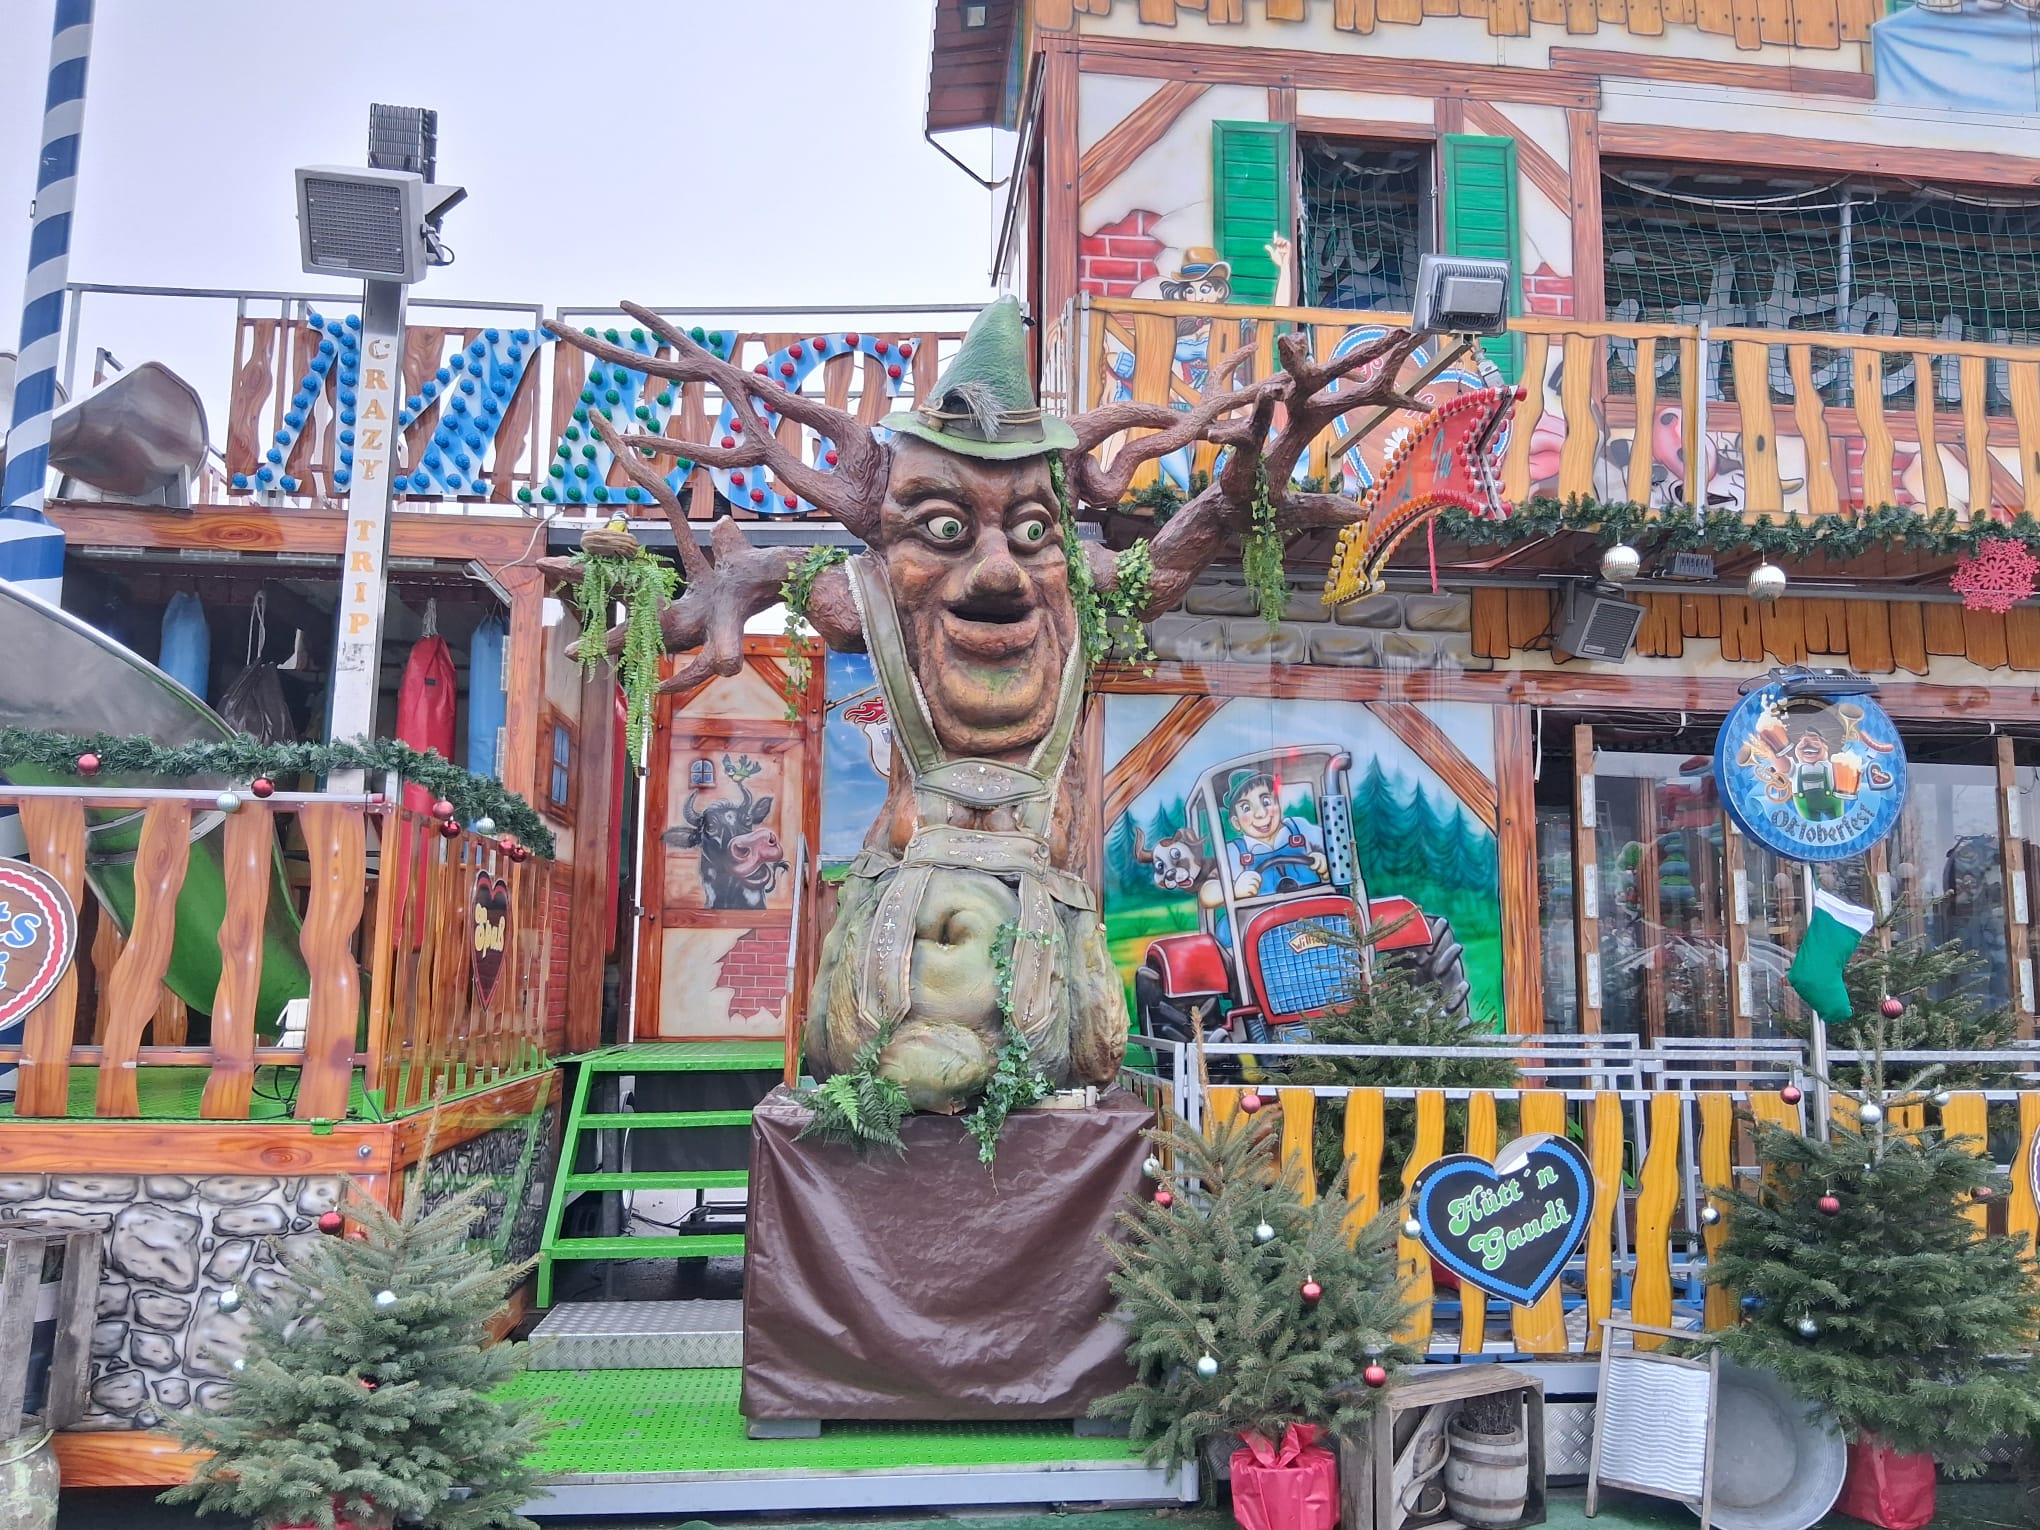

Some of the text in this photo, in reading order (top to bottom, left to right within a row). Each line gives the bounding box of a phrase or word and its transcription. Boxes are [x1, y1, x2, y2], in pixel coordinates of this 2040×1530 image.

[346, 338, 391, 635] CRAZY TRIP
[1771, 803, 1876, 843] Oktoberfest
[1468, 1198, 1572, 1271] Gaudi
